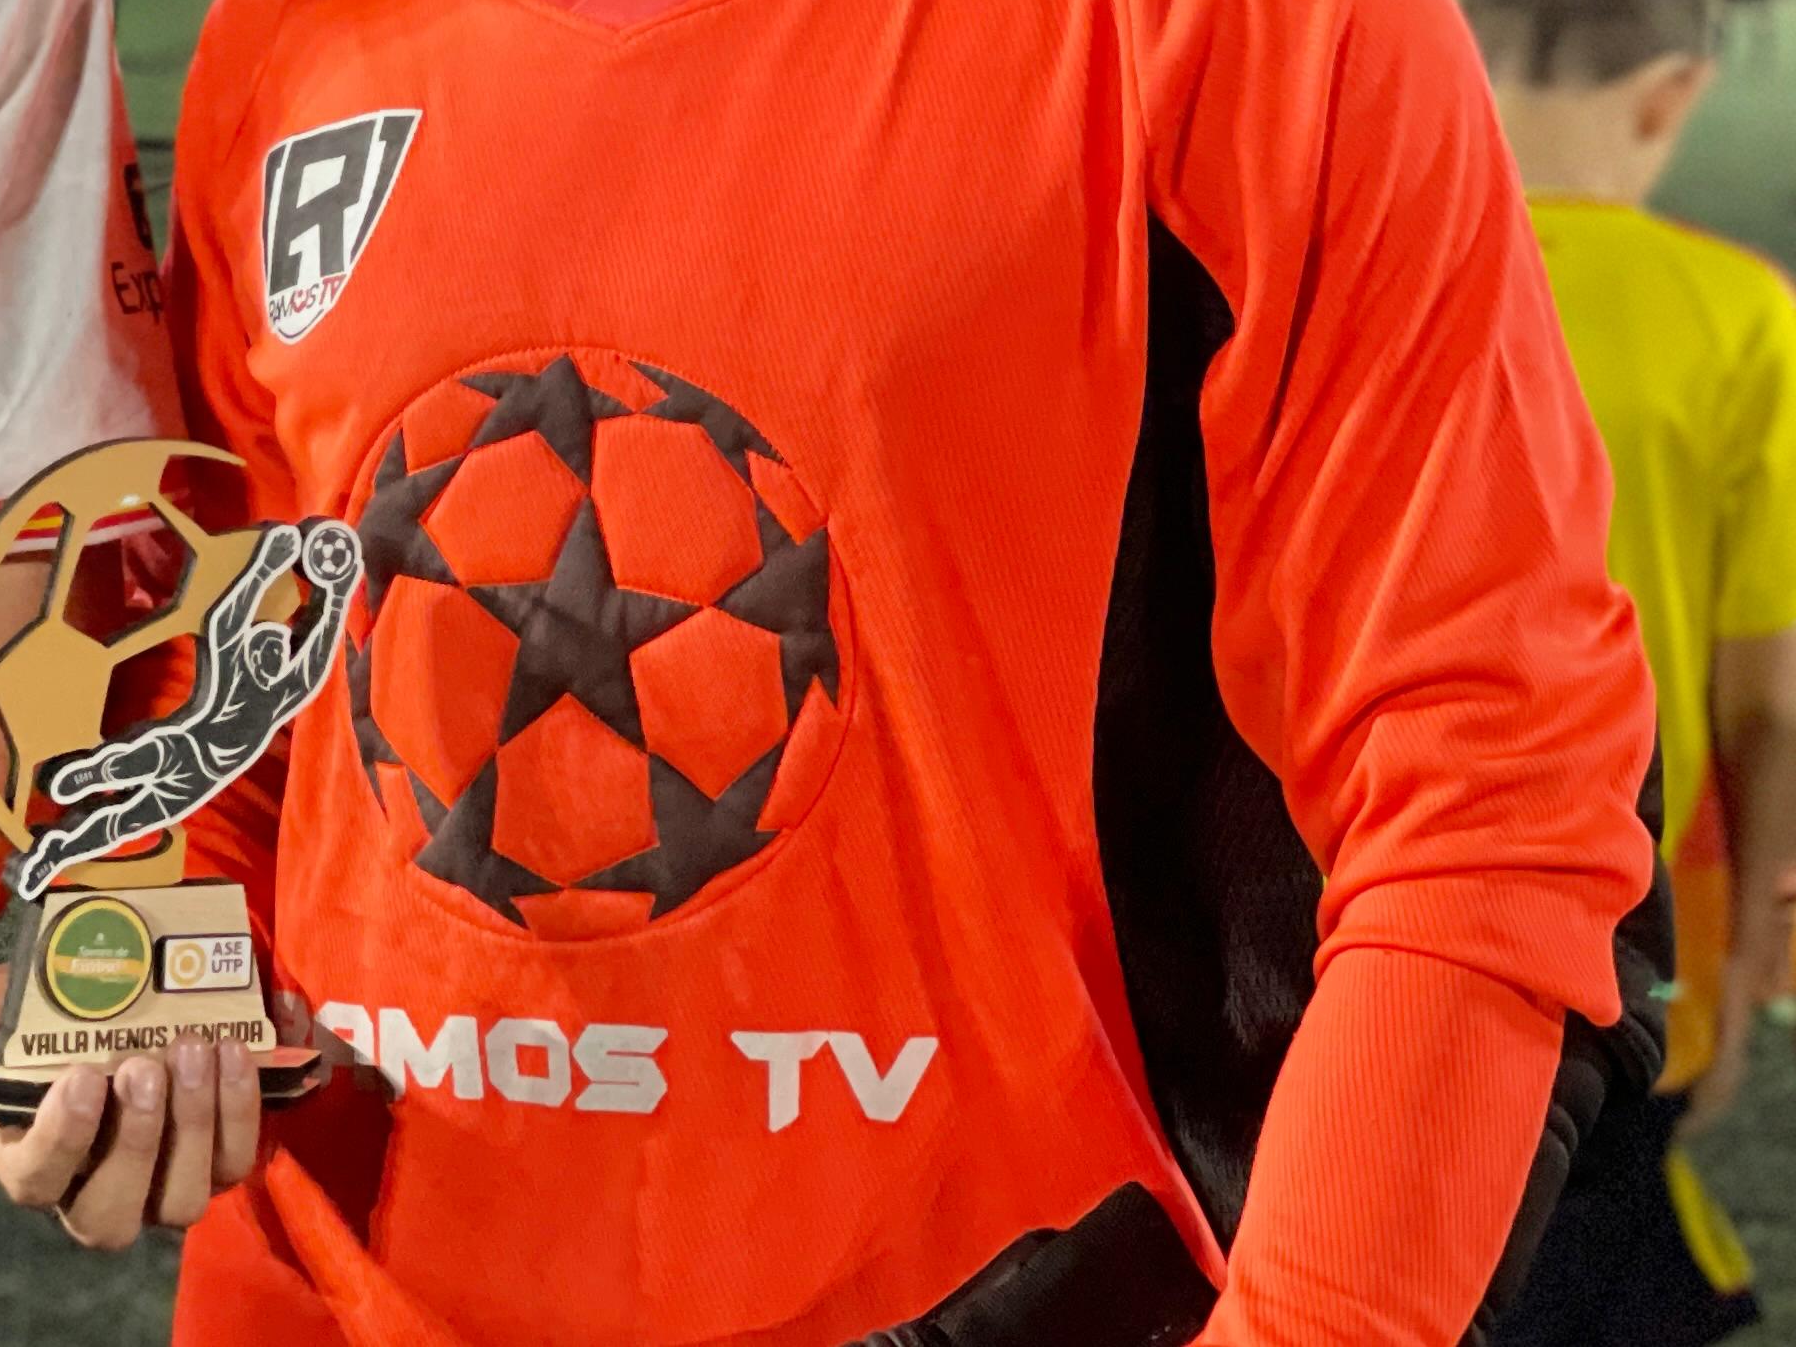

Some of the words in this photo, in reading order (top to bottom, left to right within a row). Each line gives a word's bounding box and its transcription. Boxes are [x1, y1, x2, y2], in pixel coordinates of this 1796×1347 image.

[212, 940, 243, 957] ASE
[211, 958, 243, 974] UTP
[21, 1030, 89, 1056] VALLA
[94, 1026, 168, 1052] MENOS
[729, 1030, 939, 1133] TV
